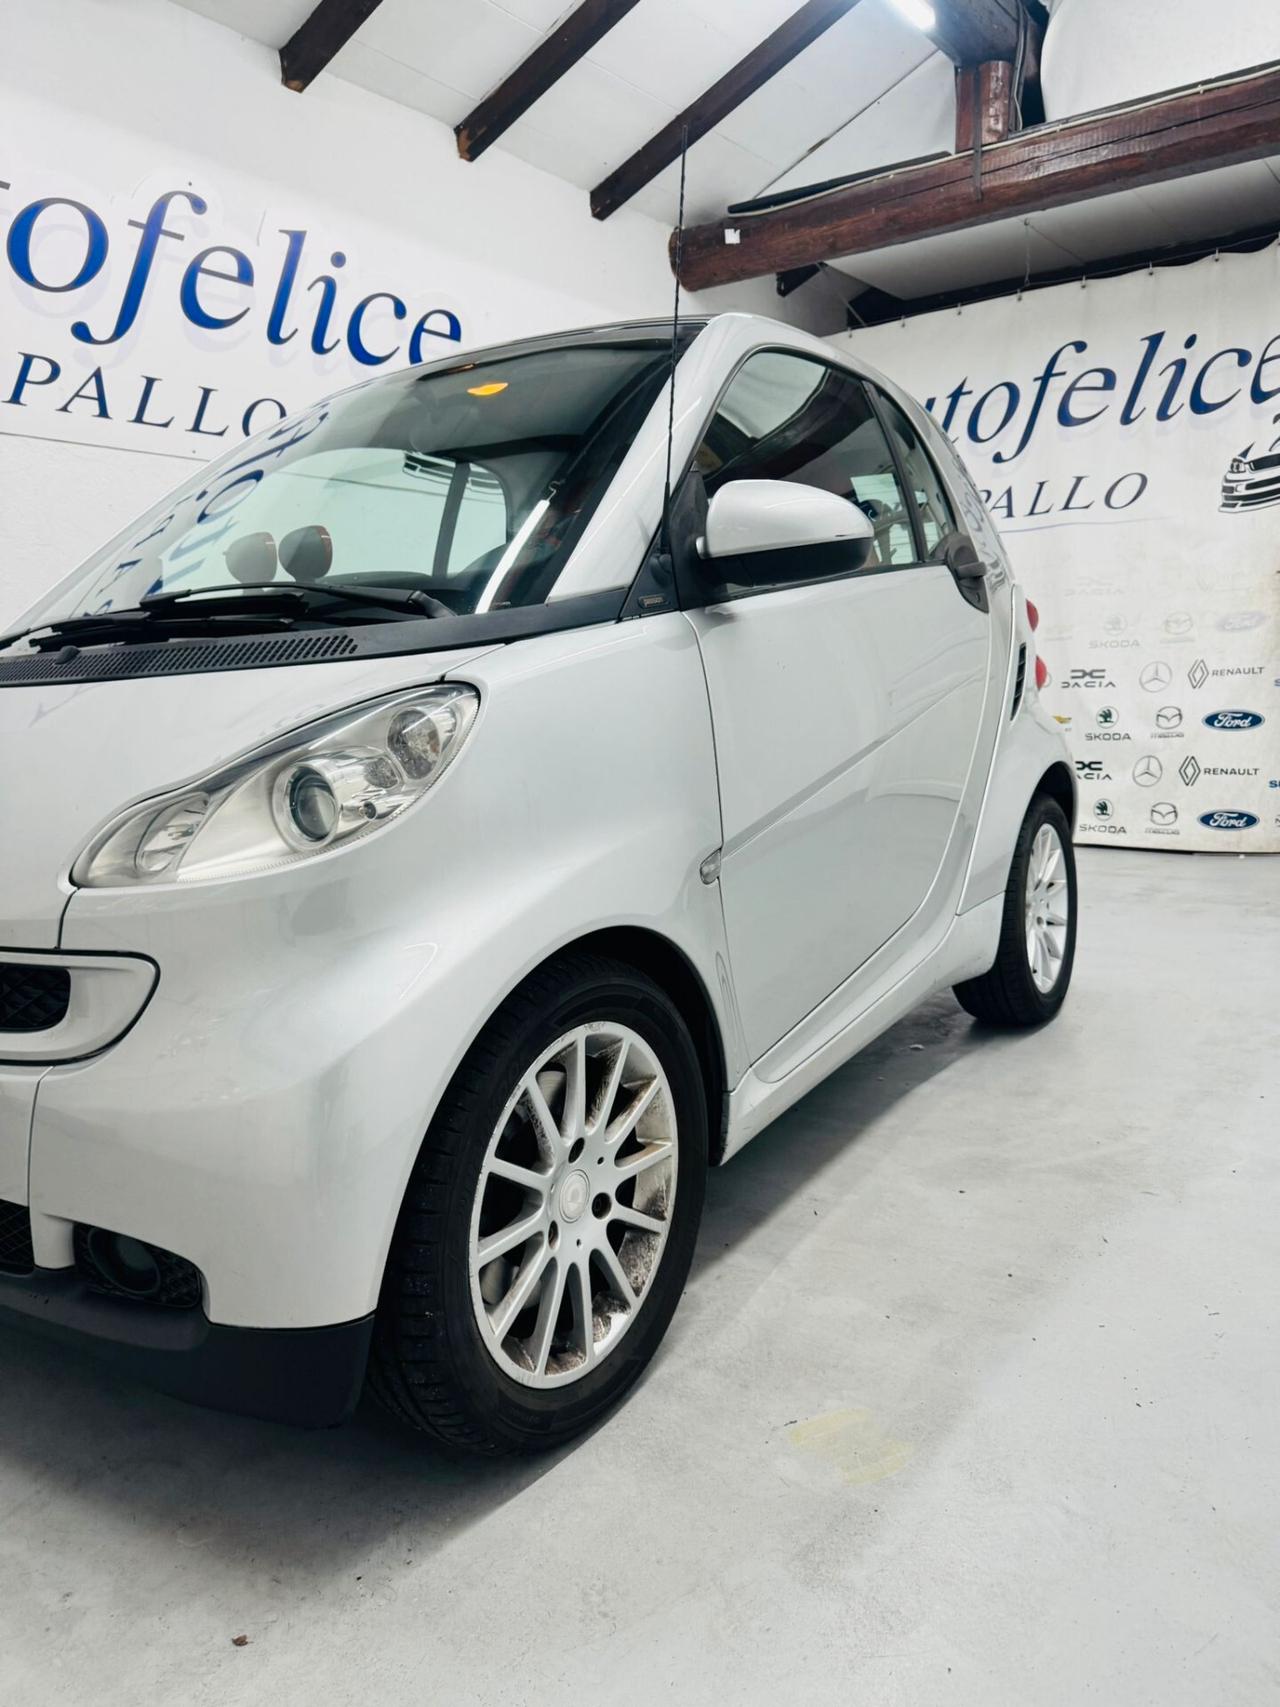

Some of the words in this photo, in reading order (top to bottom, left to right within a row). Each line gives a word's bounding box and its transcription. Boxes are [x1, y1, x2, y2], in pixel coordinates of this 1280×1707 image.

[0, 180, 463, 365] ofelice
[1211, 666, 1265, 677] RENAULT
[1213, 712, 1252, 728] Ford
[1203, 767, 1260, 776] RENAULT
[1209, 812, 1248, 828] Ford
